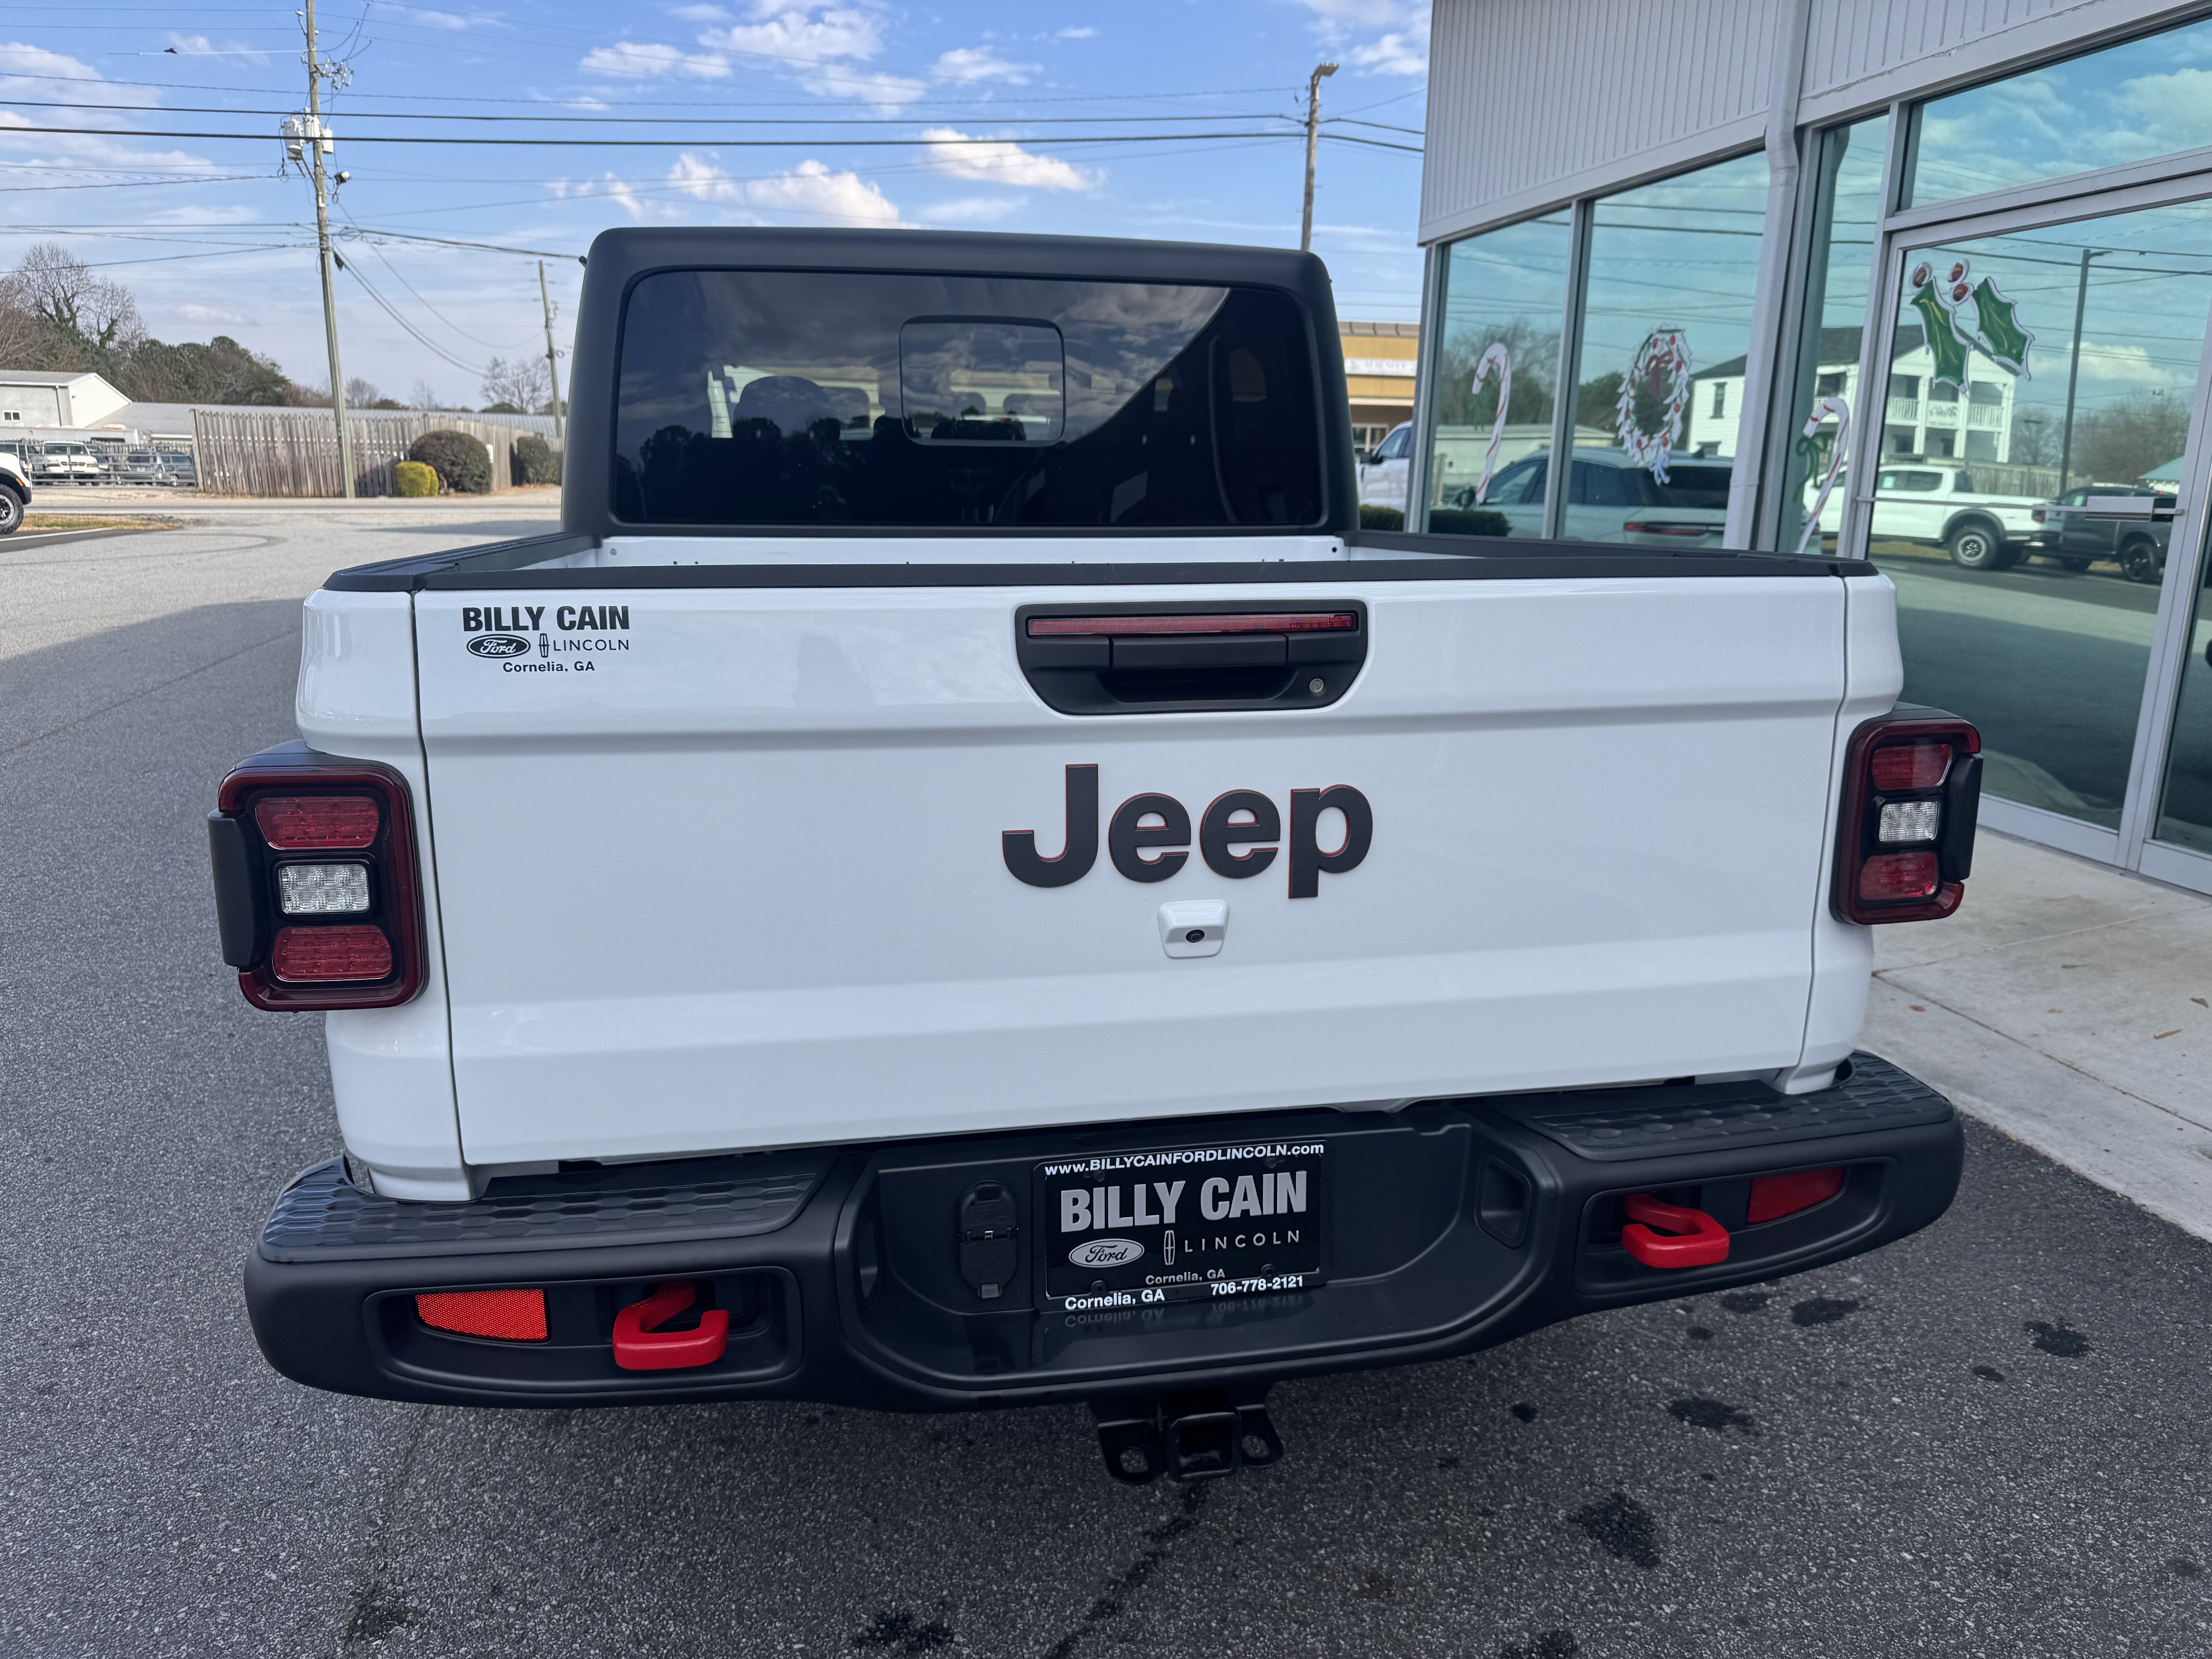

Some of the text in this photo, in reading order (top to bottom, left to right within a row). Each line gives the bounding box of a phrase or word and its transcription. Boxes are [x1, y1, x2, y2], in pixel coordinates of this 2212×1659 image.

[462, 606, 630, 632] BILLY CAIN
[480, 639, 629, 654] Ford LINCOLN
[574, 661, 595, 671] GA
[1002, 763, 1373, 899] Jeep
[1044, 1144, 1324, 1176] www.BILLYCAINFORDLINCOLN.com
[1061, 1180, 1186, 1234] BILLY
[1200, 1171, 1307, 1220] CAIN
[1085, 1230, 1299, 1263] Ford LINCOLN
[1146, 1269, 1225, 1286] Cornelia, GA
[1211, 1274, 1303, 1296] 706-778-2121
[1065, 1288, 1165, 1310] Cornelia, GA
